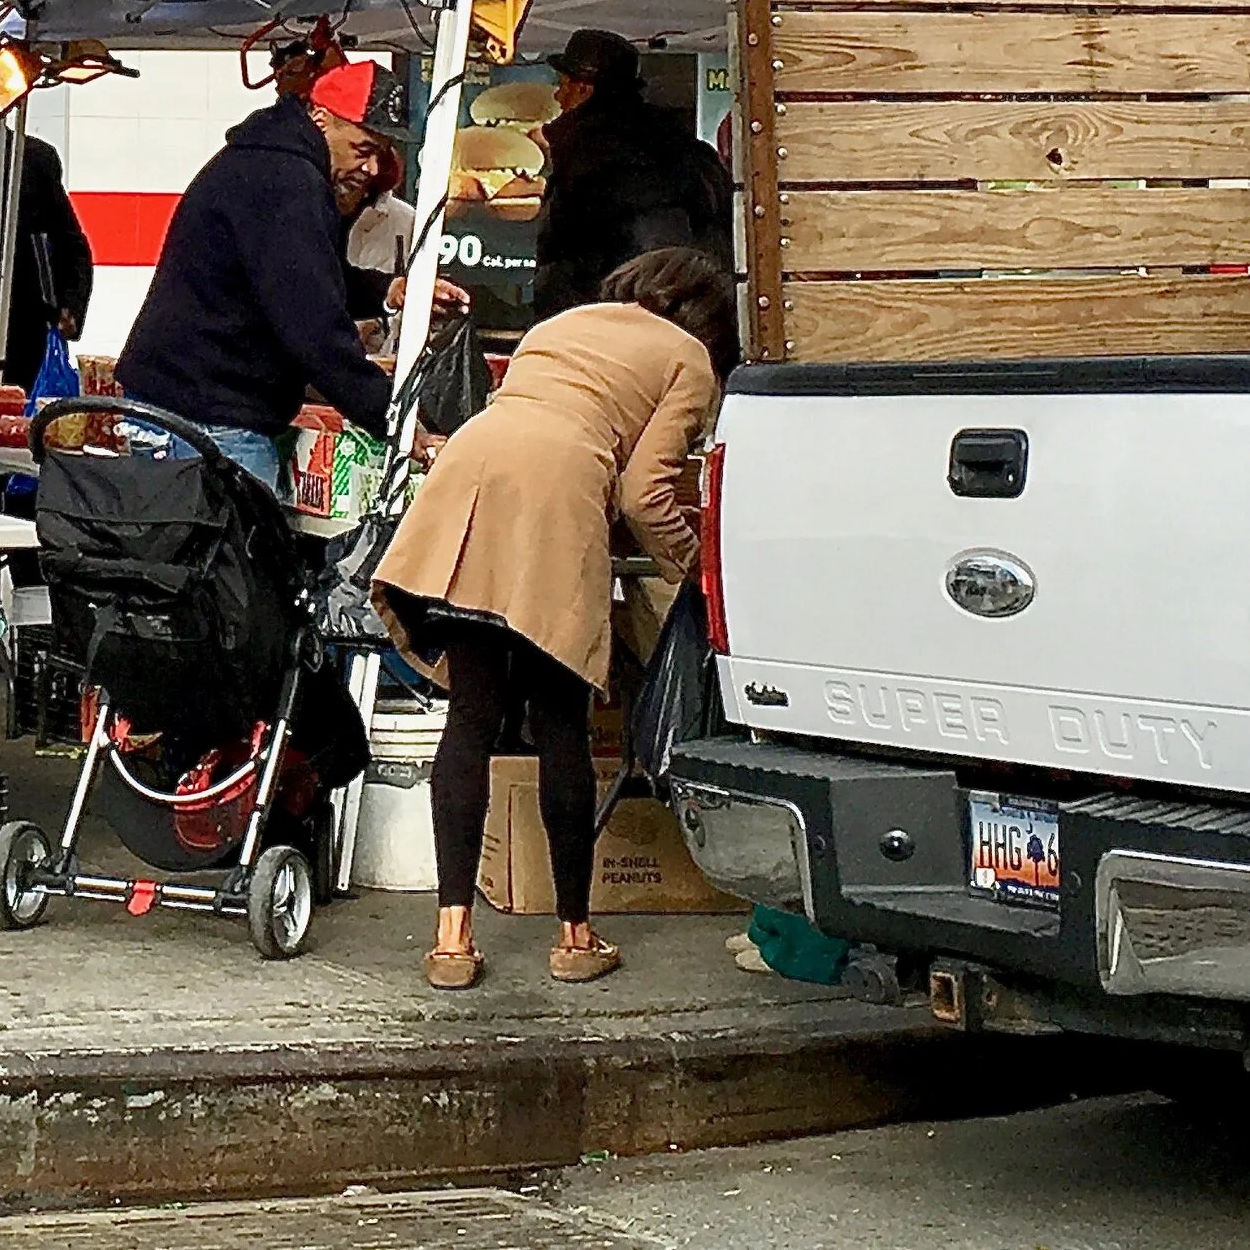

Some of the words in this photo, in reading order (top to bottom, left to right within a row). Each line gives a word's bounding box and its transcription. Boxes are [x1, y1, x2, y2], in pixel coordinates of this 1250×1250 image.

[824, 679, 1010, 746] SUPER
[1048, 704, 1219, 770] DUTY
[979, 821, 1022, 871] HHG
[602, 871, 662, 884] PEANUTS
